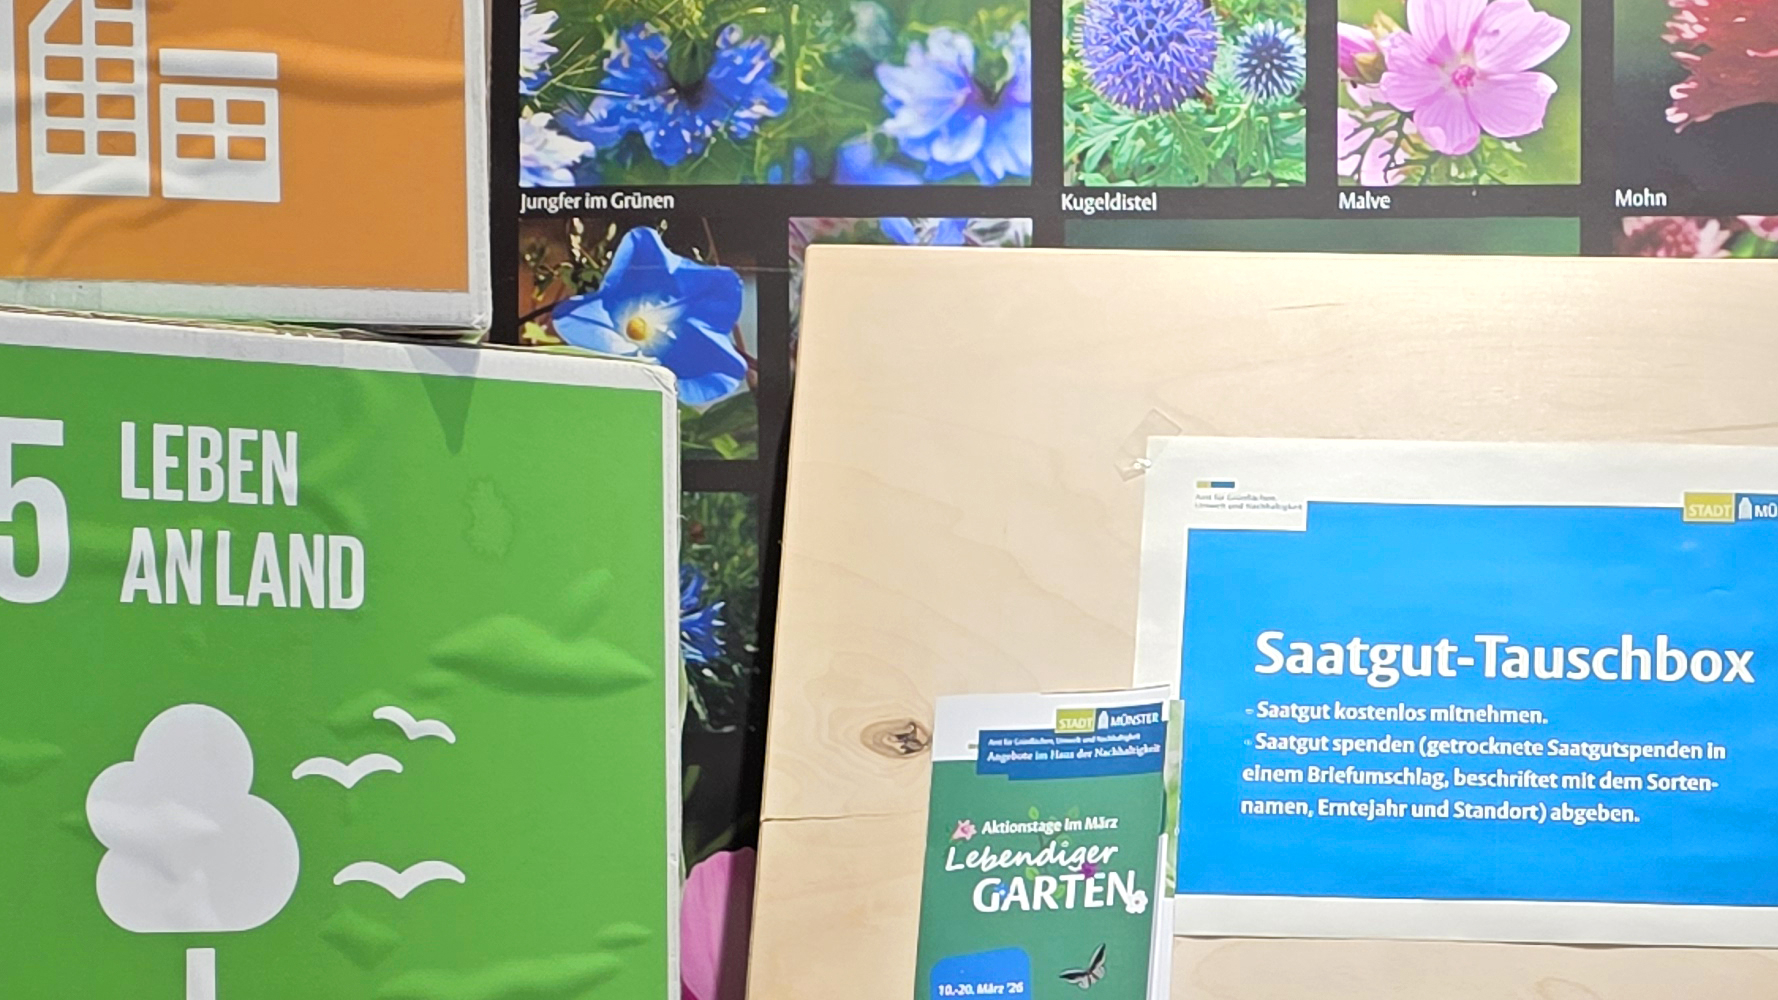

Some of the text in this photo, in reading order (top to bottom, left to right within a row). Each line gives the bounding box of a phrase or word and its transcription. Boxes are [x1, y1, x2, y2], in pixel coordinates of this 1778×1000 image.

[519, 191, 675, 214] Jungfer im Grünen
[1061, 191, 1158, 216] Kugeldistel
[1338, 190, 1391, 210] Malve
[1615, 187, 1667, 207] Mohn
[121, 421, 297, 506] LEBEN
[1688, 504, 1732, 518] STADT
[120, 527, 364, 610] AN LAND
[1254, 630, 1756, 688] Saatgut-Tauschbox
[1058, 712, 1159, 730] STADT MÜNSTER
[1257, 701, 1330, 723] Saatgut
[1334, 701, 1427, 721] kostenlos
[1430, 704, 1548, 724] mitnehmen.
[986, 744, 1161, 763] Angebote im Haus der Nachhaltigkeit
[1255, 732, 1726, 763] Saatgut spenden (getrocknete Saatgutspenden in
[1242, 764, 1719, 791] einem Briefumschlag, beschriftet mit dem Sorten-
[1240, 799, 1640, 826] namen, Erntejahr und Standort) abgeben.
[981, 816, 1118, 835] Aktionstage im März
[945, 840, 1119, 872] Lebendiger
[972, 870, 1136, 913] GARTEN
[977, 983, 1004, 995] März
